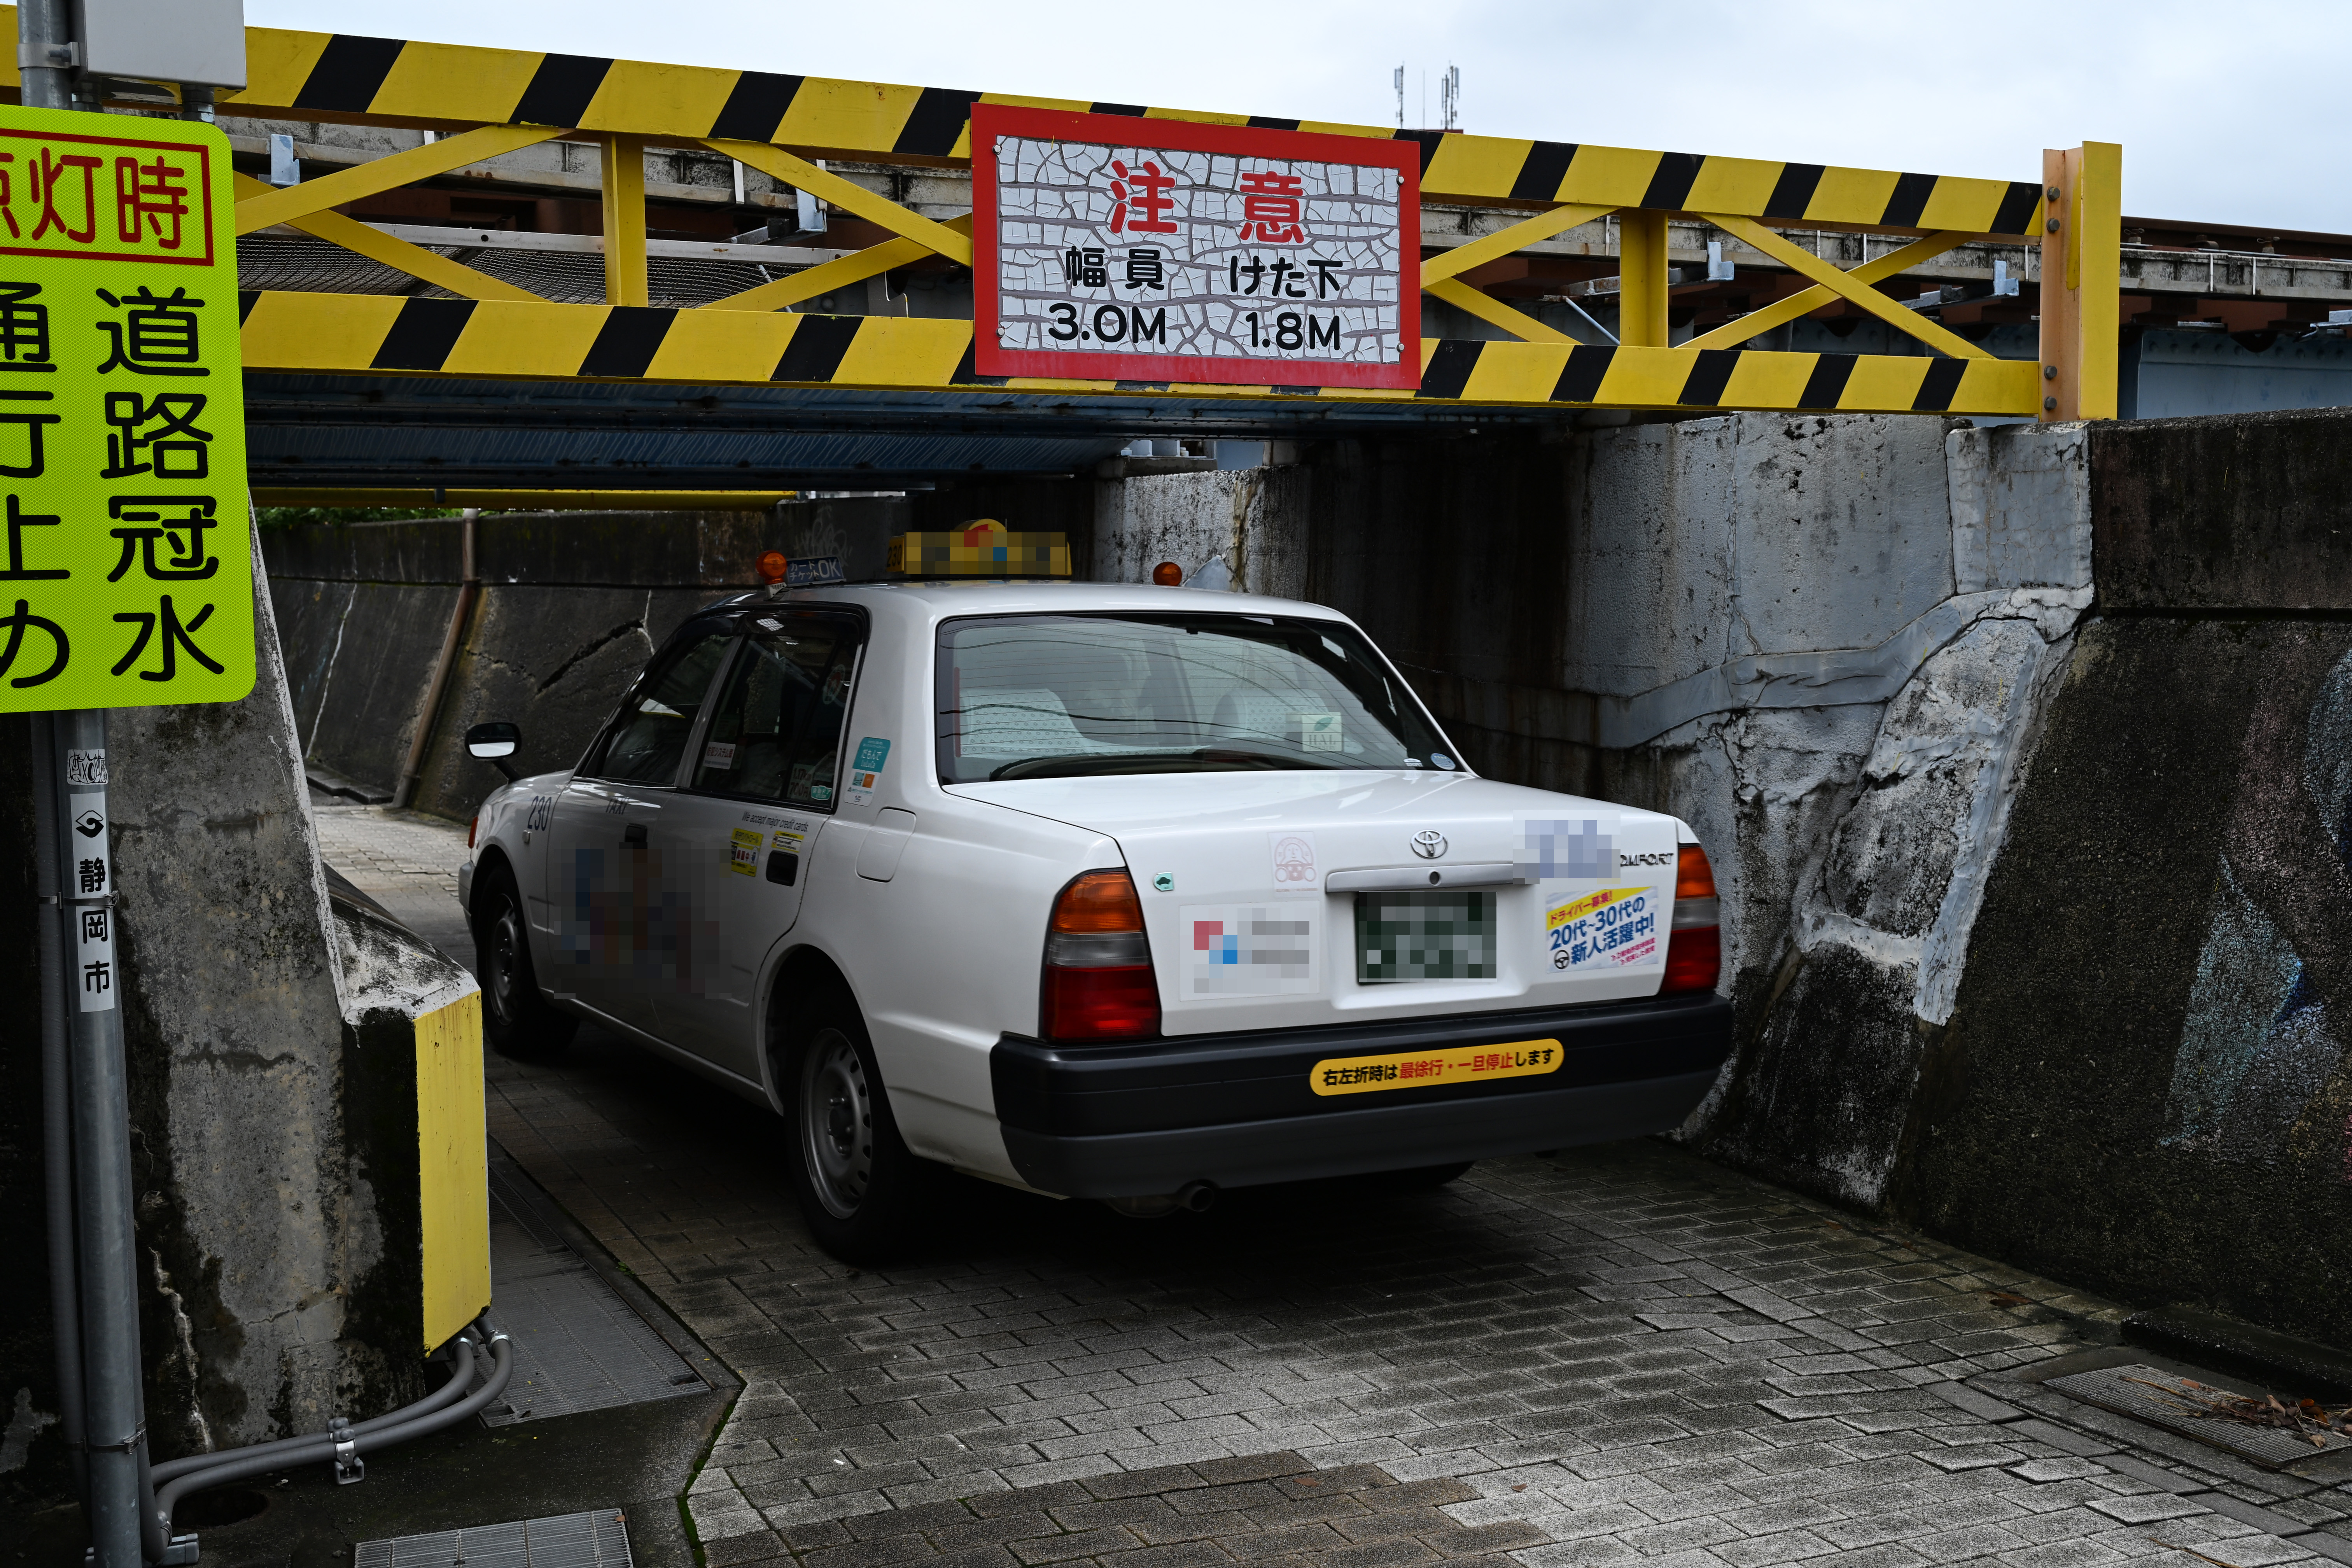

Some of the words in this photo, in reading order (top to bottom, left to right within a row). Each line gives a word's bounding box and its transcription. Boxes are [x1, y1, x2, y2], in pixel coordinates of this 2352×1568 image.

[1110, 160, 1304, 243] 注意
[1066, 246, 1165, 290] 幅員
[1230, 255, 1342, 299] けた下
[1048, 303, 1166, 345] 3.0M
[1245, 312, 1340, 351] 1.8M
[95, 285, 225, 682] 道路冠水
[790, 560, 815, 571] カード
[887, 544, 902, 567] 230
[789, 570, 819, 581] チケット
[818, 558, 841, 578] OK
[1309, 734, 1336, 745] HAL
[527, 795, 551, 831] 230
[606, 796, 629, 815] TAXI
[742, 811, 751, 822] We
[749, 815, 766, 826] accept
[765, 816, 780, 828] major
[779, 819, 795, 829] credit
[79, 857, 110, 994] 静岡市
